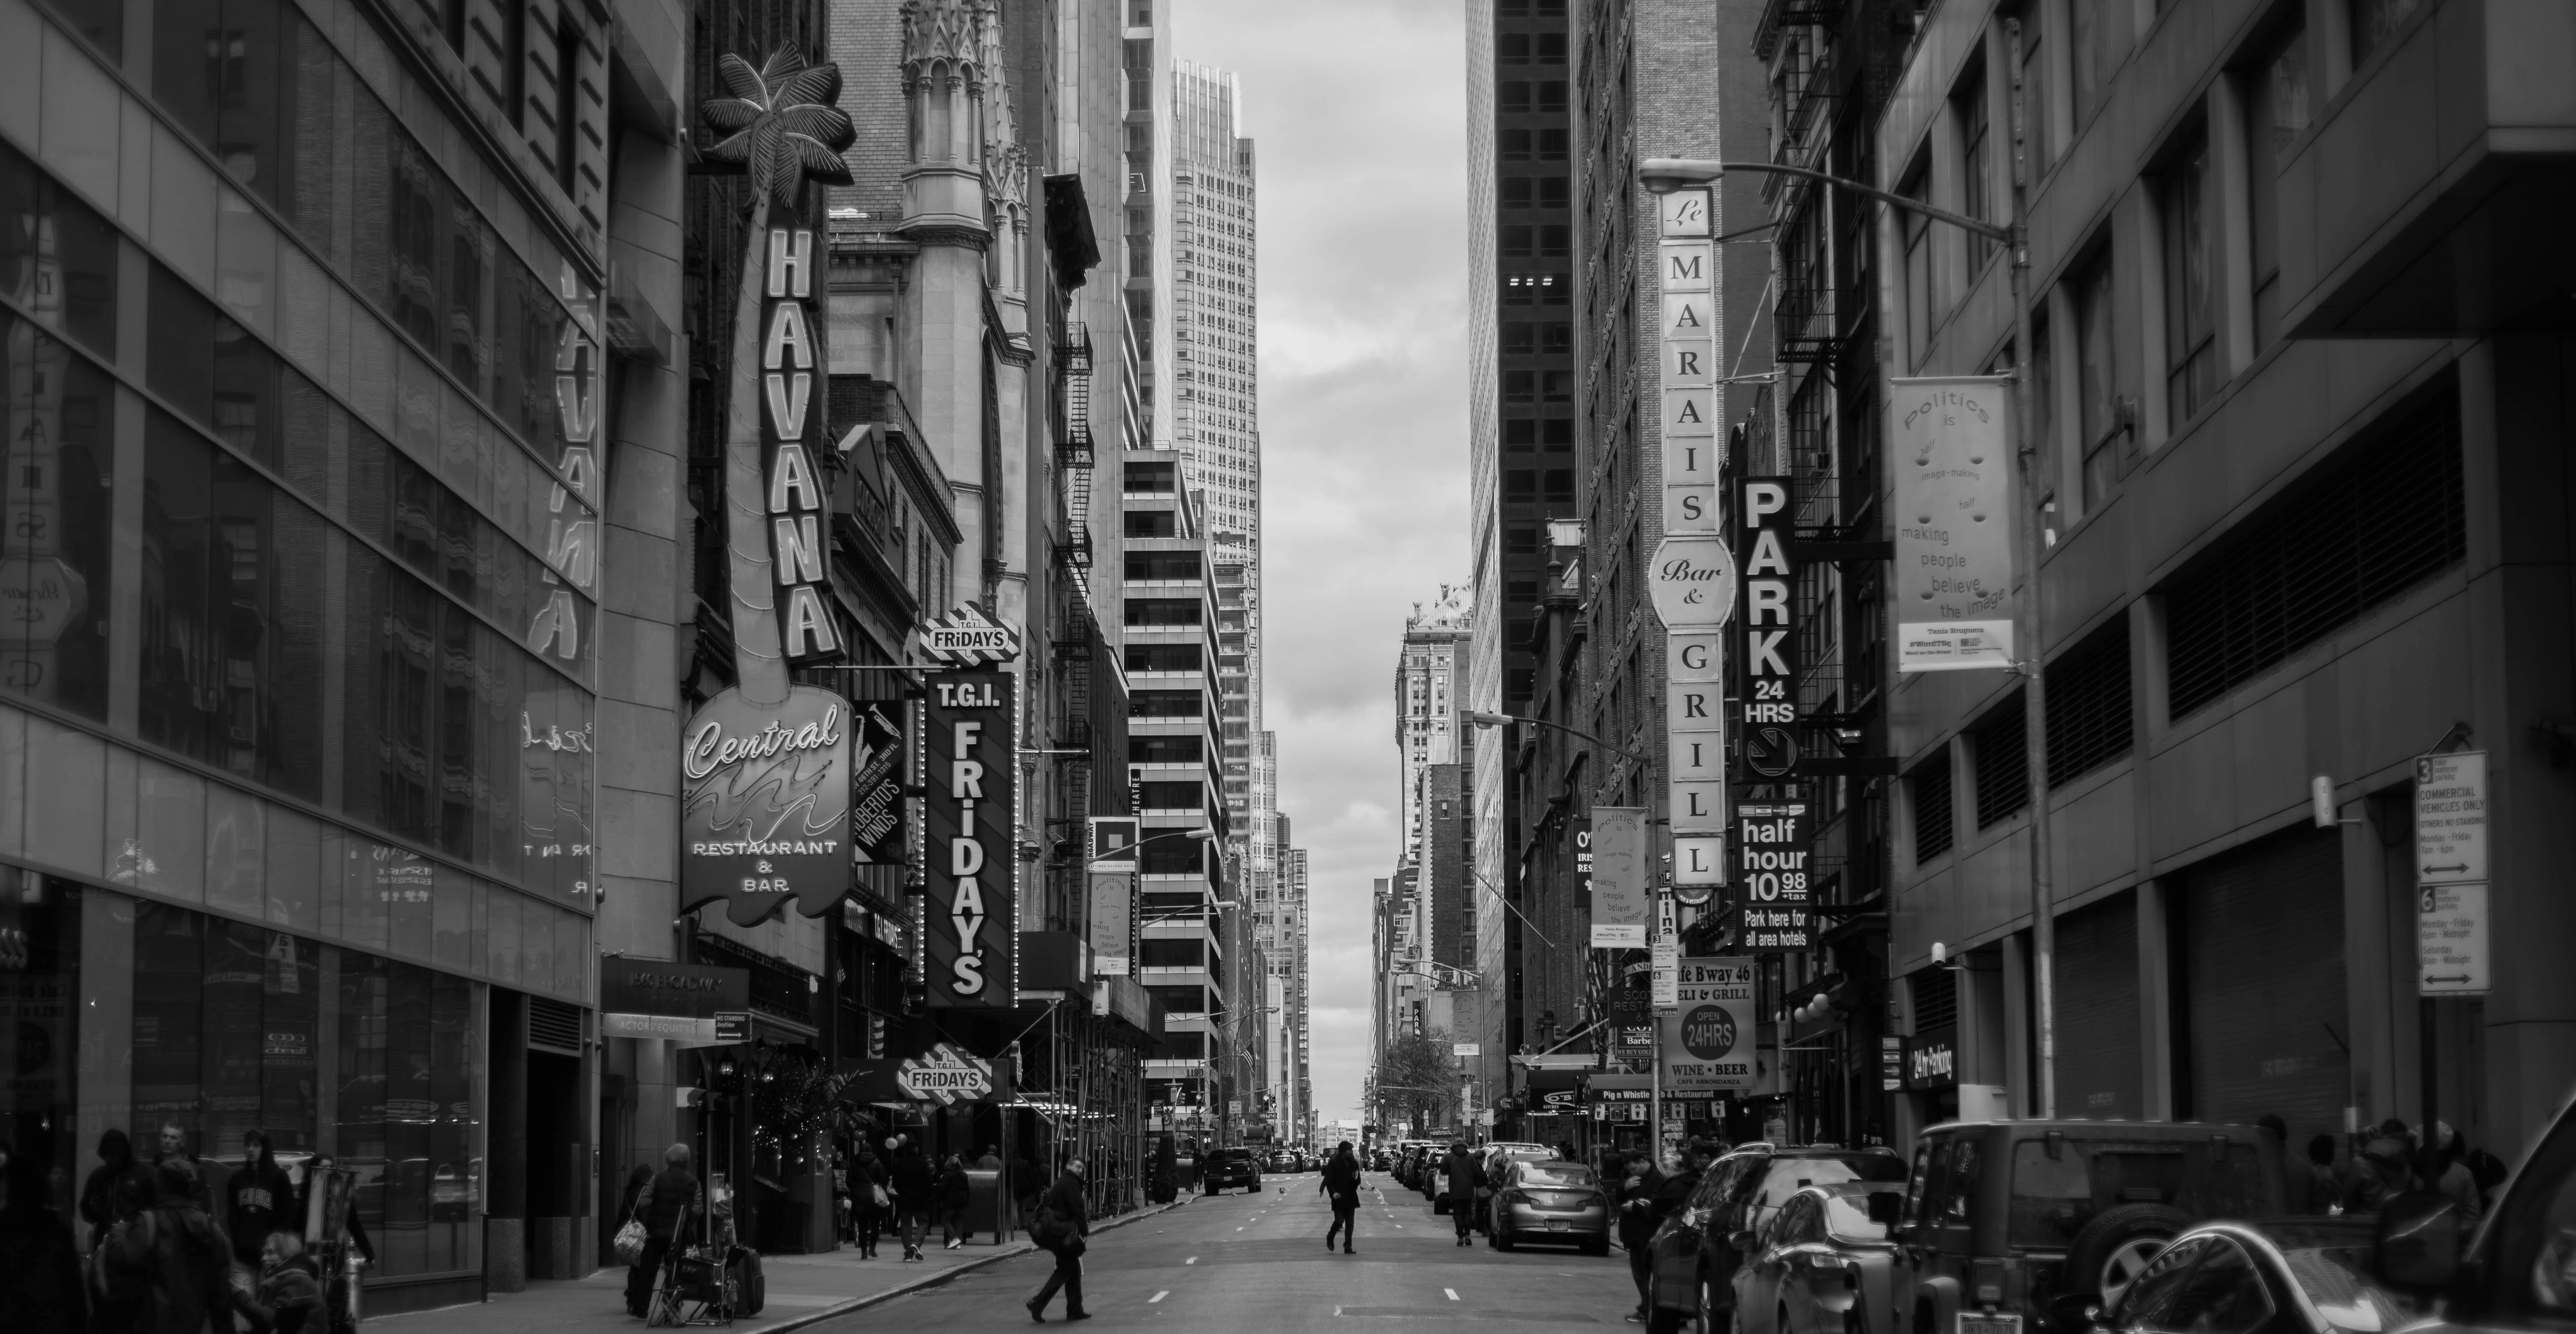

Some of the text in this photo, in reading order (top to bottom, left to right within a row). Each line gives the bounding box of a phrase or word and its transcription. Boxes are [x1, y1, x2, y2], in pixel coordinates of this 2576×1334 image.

[1666, 198, 1703, 227] Le
[1670, 255, 1703, 520] MARAIS
[1944, 414, 1956, 426] is
[764, 230, 837, 657] HAVANA
[1920, 439, 1935, 457] half
[1959, 497, 1975, 510] half
[1902, 527, 1949, 546] making
[1922, 552, 1966, 570] people
[1661, 558, 1723, 583] Bar
[1746, 483, 1790, 675] PARK
[1932, 575, 1981, 594] believe
[1941, 588, 2006, 619] the image
[938, 683, 1000, 707] T.G.I.
[1755, 681, 1785, 700] 24
[1745, 704, 1795, 723] HRS
[686, 703, 840, 778] Central
[1682, 645, 1708, 872] GRILL
[2419, 760, 2432, 784] 3
[2435, 765, 2458, 773] metered
[2435, 773, 2456, 782] parking
[858, 761, 891, 795] 212-391-1315
[1132, 777, 1140, 816] THEATRE
[2420, 787, 2476, 801] COMMERCIAL
[2421, 799, 2485, 814] VEHICLES ONLY
[858, 809, 897, 847] WINDS
[1743, 819, 1795, 843] half
[2421, 816, 2486, 829] OTHERS NO STANDING
[1577, 831, 1592, 848] O'
[2421, 832, 2472, 844] Monday Friday
[693, 842, 838, 856] RESTAURANT
[2421, 844, 2455, 854] 7am 6pm
[1744, 846, 1807, 870] hour
[758, 860, 772, 874] &
[742, 879, 790, 892] BAR
[1594, 878, 1617, 889] making
[1744, 873, 1807, 901] 10 98
[1603, 892, 1624, 901] people
[2421, 889, 2433, 912] 6
[2437, 894, 2461, 903] metered
[1607, 903, 1631, 912] believe
[2437, 902, 2459, 911] parking
[1623, 910, 1642, 923] image
[1745, 909, 1807, 928] Park here for
[2422, 918, 2475, 930] Monday Friday
[1746, 929, 1807, 947] all area hotels
[2423, 929, 2471, 940] 6pm Midnight
[2423, 945, 2453, 955] Saturday
[2423, 955, 2472, 966] 8am Midnight
[1679, 965, 1692, 982] fé
[1736, 965, 1750, 982] 46
[1699, 989, 1709, 1000] &
[1713, 989, 1750, 1000] GRILL
[1697, 1012, 1720, 1021] OPEN
[1688, 1024, 1732, 1047] 24HRS
[1671, 1064, 1748, 1076] WINE BEER
[1929, 1043, 1952, 1080] Parking
[1603, 1091, 1615, 1100] Pig
[1623, 1090, 1650, 1099] Whistle
[1675, 1090, 1714, 1098] Restaurant
[237, 1188, 274, 1210] GEORGIA
